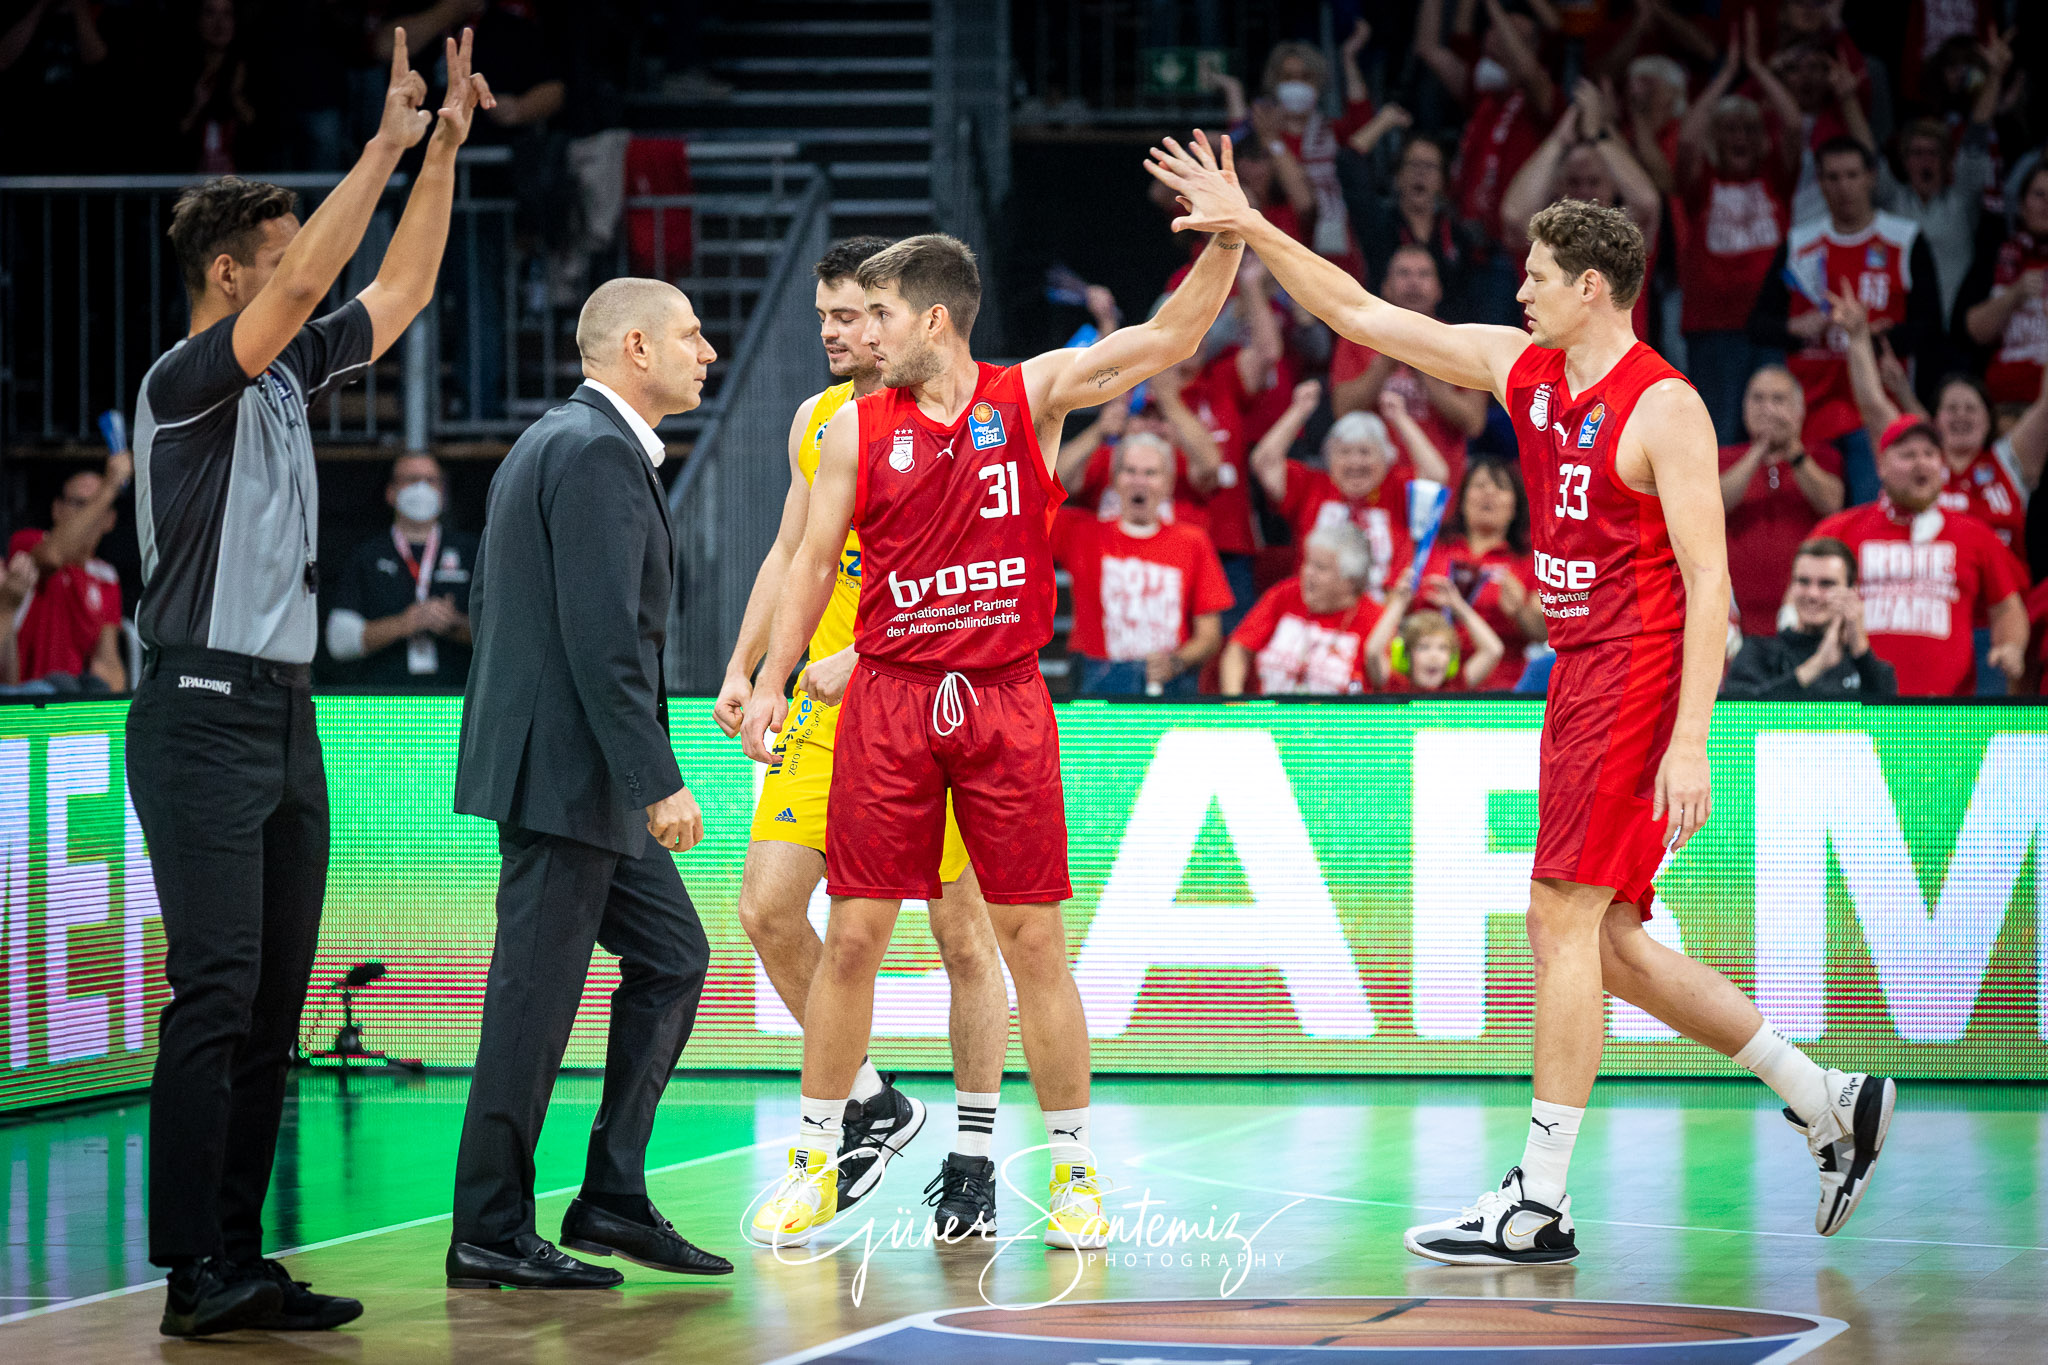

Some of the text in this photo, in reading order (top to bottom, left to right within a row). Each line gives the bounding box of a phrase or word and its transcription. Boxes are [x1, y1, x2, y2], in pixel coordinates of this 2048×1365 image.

[977, 432, 1002, 447] BBL
[978, 461, 1020, 519] 31
[1555, 463, 1592, 521] 33
[888, 556, 1026, 608] brose
[1534, 549, 1597, 590] rose
[974, 598, 1018, 612] Partner
[1557, 591, 1590, 603] artner
[886, 611, 1020, 638] der Automobilindustrie
[178, 675, 232, 695] SPALDING
[788, 753, 801, 776] zero
[795, 727, 813, 750] wate
